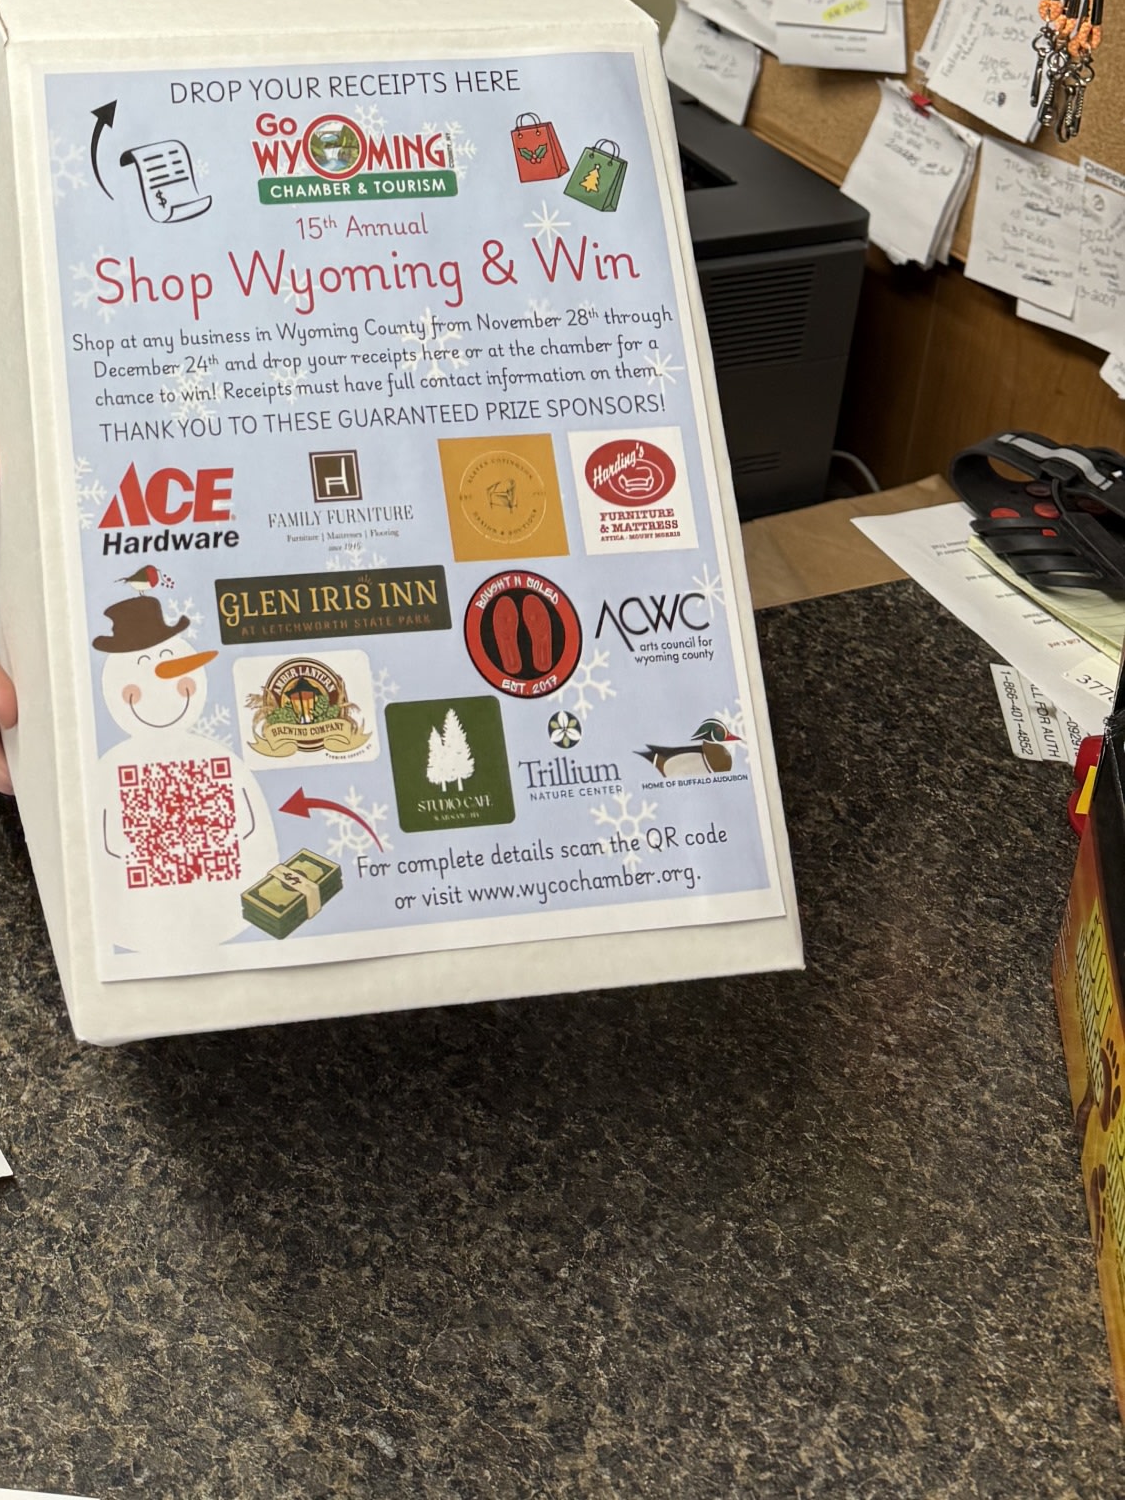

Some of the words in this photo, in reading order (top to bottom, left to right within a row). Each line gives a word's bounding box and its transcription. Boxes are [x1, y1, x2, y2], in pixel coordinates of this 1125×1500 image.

[170, 80, 242, 104] DROP
[249, 76, 322, 101] YOUR
[329, 72, 447, 98] RECEIPTS
[455, 69, 521, 93] HERE
[256, 112, 298, 137] Go
[252, 114, 446, 181] WYOMING
[270, 182, 351, 199] CHAMBER
[358, 181, 368, 195] &
[374, 178, 446, 194] TOURISM
[1084, 161, 1125, 189] CHIPPEW
[296, 215, 337, 240] 15th
[346, 212, 429, 238] Annual
[95, 256, 213, 321] Shop
[227, 248, 464, 315] Wyoming
[481, 239, 518, 286] &
[531, 235, 641, 283] Win
[73, 333, 114, 356] Shop
[120, 334, 137, 349] at
[143, 334, 174, 354] any
[180, 328, 251, 347] business
[256, 327, 272, 342] in
[275, 322, 359, 346] Wyoming
[364, 317, 426, 340] County
[431, 315, 473, 339] from
[476, 312, 562, 332] November
[566, 308, 599, 328] 28th
[603, 304, 673, 329] through
[94, 362, 180, 379] December
[185, 355, 219, 373] 24th
[225, 353, 258, 371] and
[263, 351, 302, 375] drop
[307, 354, 348, 374] your
[350, 343, 417, 370] receipts
[422, 343, 460, 361] here
[465, 348, 483, 359] or
[489, 343, 505, 358] at
[509, 340, 535, 358] the
[540, 336, 613, 356] chamber
[617, 334, 643, 358] for
[648, 338, 659, 350] a
[95, 387, 155, 407] chance
[159, 387, 176, 403] to
[181, 383, 217, 402] win!
[223, 382, 292, 404] Receipts
[296, 377, 340, 395] must
[344, 374, 383, 392] have
[387, 372, 415, 397] full
[419, 368, 483, 389] contact
[486, 364, 586, 392] information
[590, 368, 610, 381] on
[615, 361, 663, 380] them.
[99, 420, 176, 442] THANK
[177, 416, 222, 438] YOU
[228, 415, 258, 435] TO
[263, 411, 333, 433] THESE
[337, 403, 480, 429] GUARANTEED
[486, 400, 540, 421] PRIZE
[546, 393, 665, 418] SPONSORS!
[592, 442, 645, 490] Harding's
[97, 461, 235, 529] ACE
[267, 509, 322, 529] FAMILY
[327, 504, 414, 527] FURNITURE
[599, 508, 675, 522] FURNITURE
[600, 523, 610, 533] &
[612, 520, 679, 532] MATTRESS
[102, 528, 240, 556] Hardware
[219, 588, 301, 627] GLEN
[308, 583, 372, 614] IRIS
[378, 578, 439, 608] INN
[475, 576, 511, 611] BOUGHT
[241, 626, 257, 638] AT
[261, 618, 348, 636] LETCHWORTH
[354, 616, 393, 629] STATE
[595, 592, 710, 652] ACWC
[634, 652, 680, 667] wyoming
[681, 648, 715, 662] county
[639, 640, 659, 652] arts
[661, 636, 695, 651] council
[697, 636, 713, 648] for
[273, 668, 299, 697] AMBER
[298, 666, 336, 693] LANTERN
[532, 674, 559, 694] 2017
[1035, 701, 1050, 725] FOR
[271, 726, 309, 738] BREWING
[309, 721, 345, 736] COMPANY
[1042, 726, 1061, 758] AUTH
[518, 754, 622, 790] Trillium
[642, 781, 663, 790] HOME
[665, 780, 675, 788] OF
[677, 776, 711, 787] BUFFALO
[529, 788, 575, 801] NATURE
[579, 784, 623, 797] CENTER
[356, 856, 391, 878] For
[397, 847, 485, 879] complete
[491, 838, 554, 867] details
[560, 840, 604, 859] scan
[609, 831, 640, 854] the
[645, 826, 679, 852] QR
[684, 822, 728, 847] code
[395, 894, 417, 911] or
[422, 884, 463, 908] visit
[467, 864, 702, 905] www.wycochamber.org.
